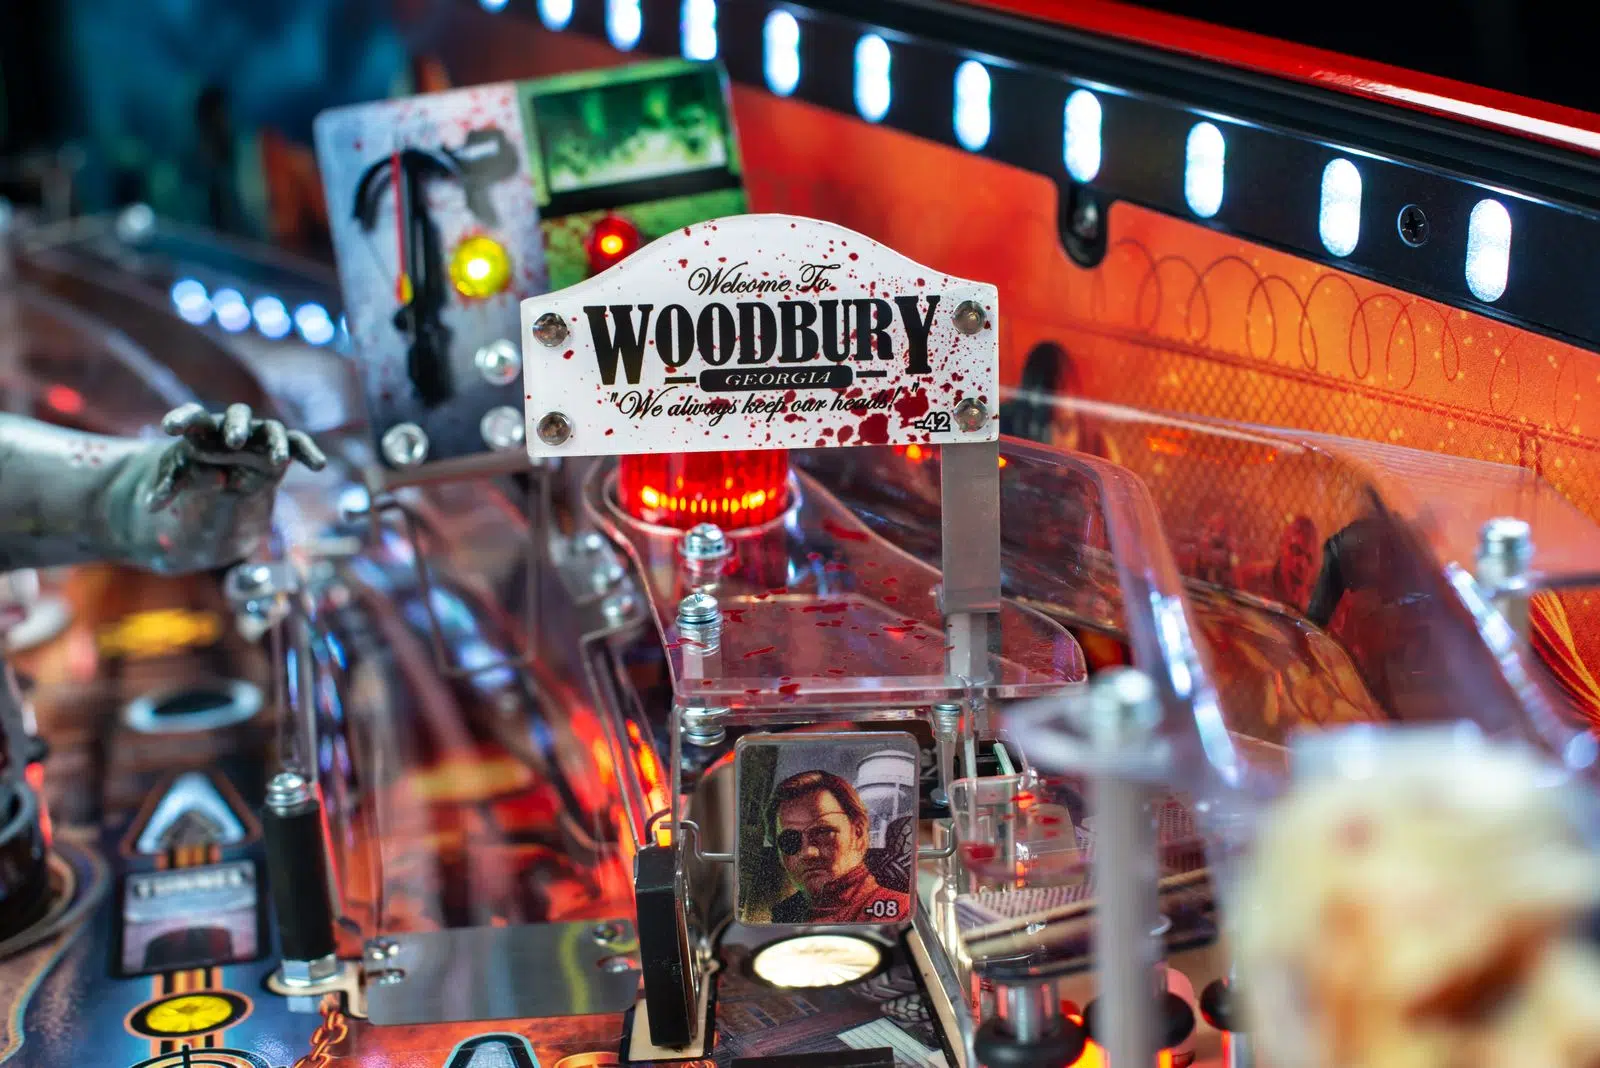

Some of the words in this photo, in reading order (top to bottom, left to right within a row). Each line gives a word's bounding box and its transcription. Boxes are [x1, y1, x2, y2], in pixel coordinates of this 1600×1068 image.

[688, 260, 791, 296] Welcome
[796, 263, 841, 292] To
[583, 295, 941, 385] WOODBURY
[725, 372, 831, 387] GEORGIA
[667, 395, 738, 427] always
[741, 393, 787, 423] keep
[791, 398, 828, 413] our
[914, 411, 951, 432] -42
[865, 900, 899, 918] -08
